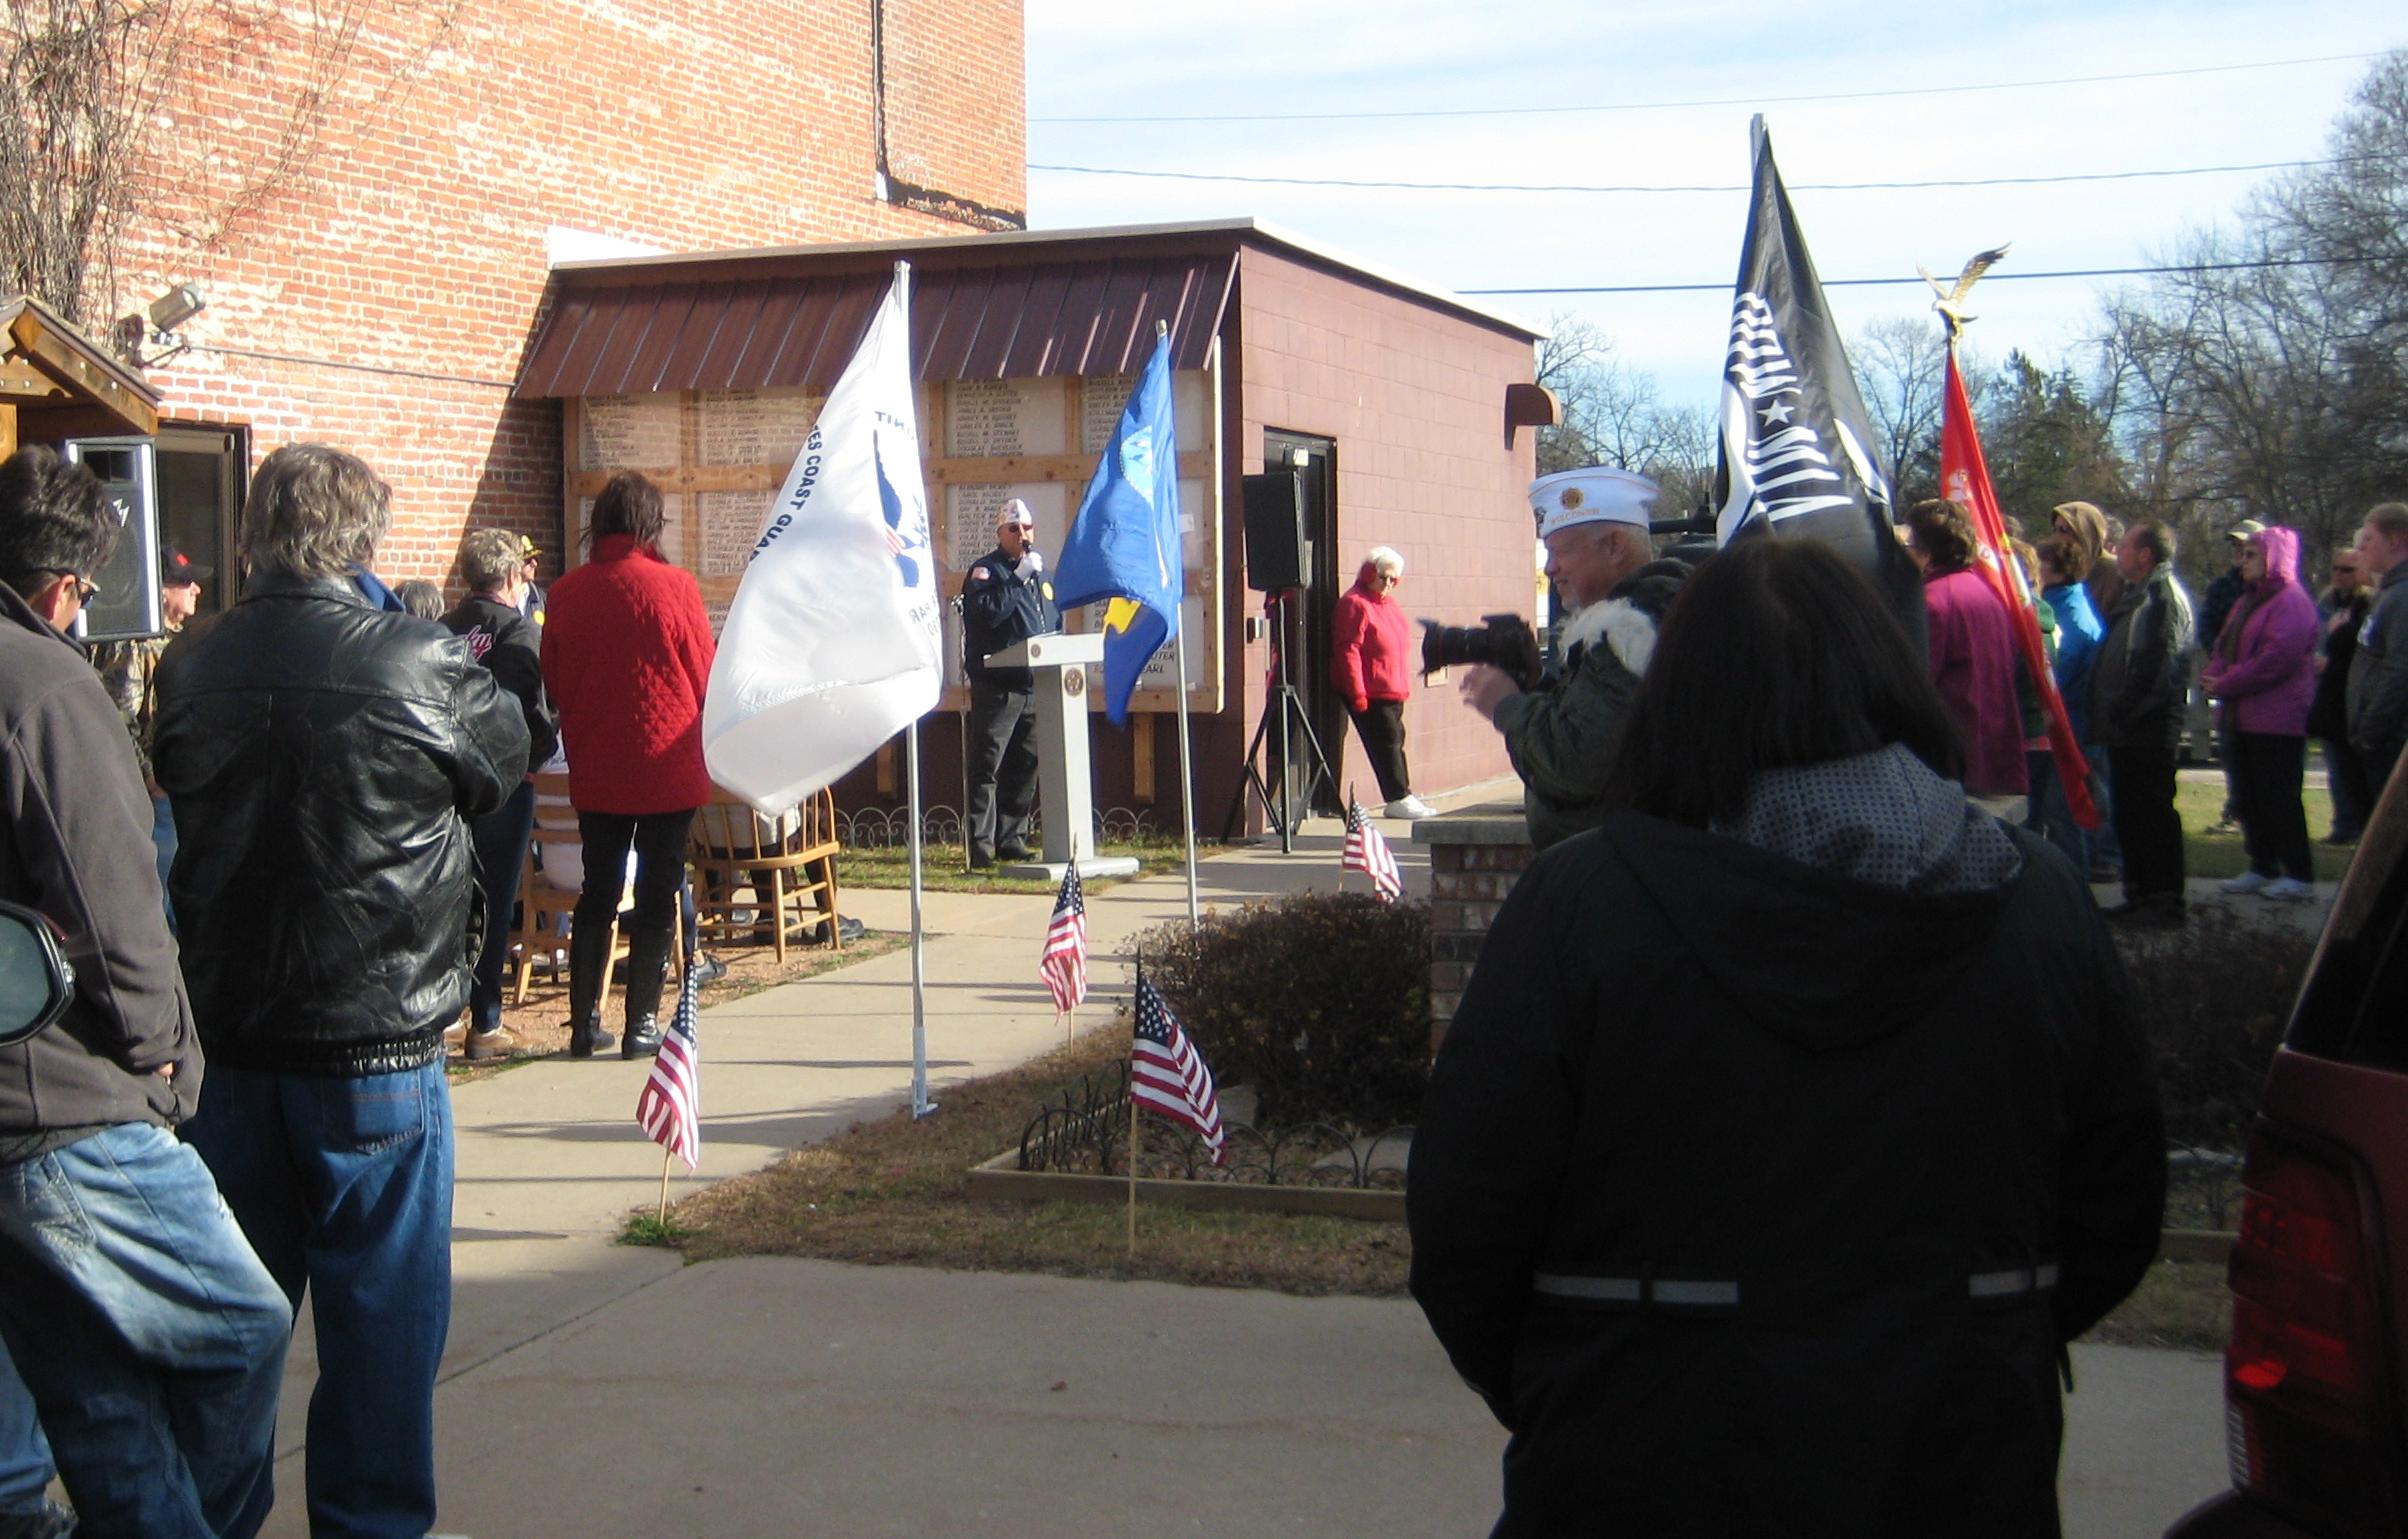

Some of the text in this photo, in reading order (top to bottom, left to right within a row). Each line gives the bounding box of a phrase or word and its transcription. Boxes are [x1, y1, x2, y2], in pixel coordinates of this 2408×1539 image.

[1728, 292, 1853, 522] POW MIA
[790, 455, 822, 511] COAST
